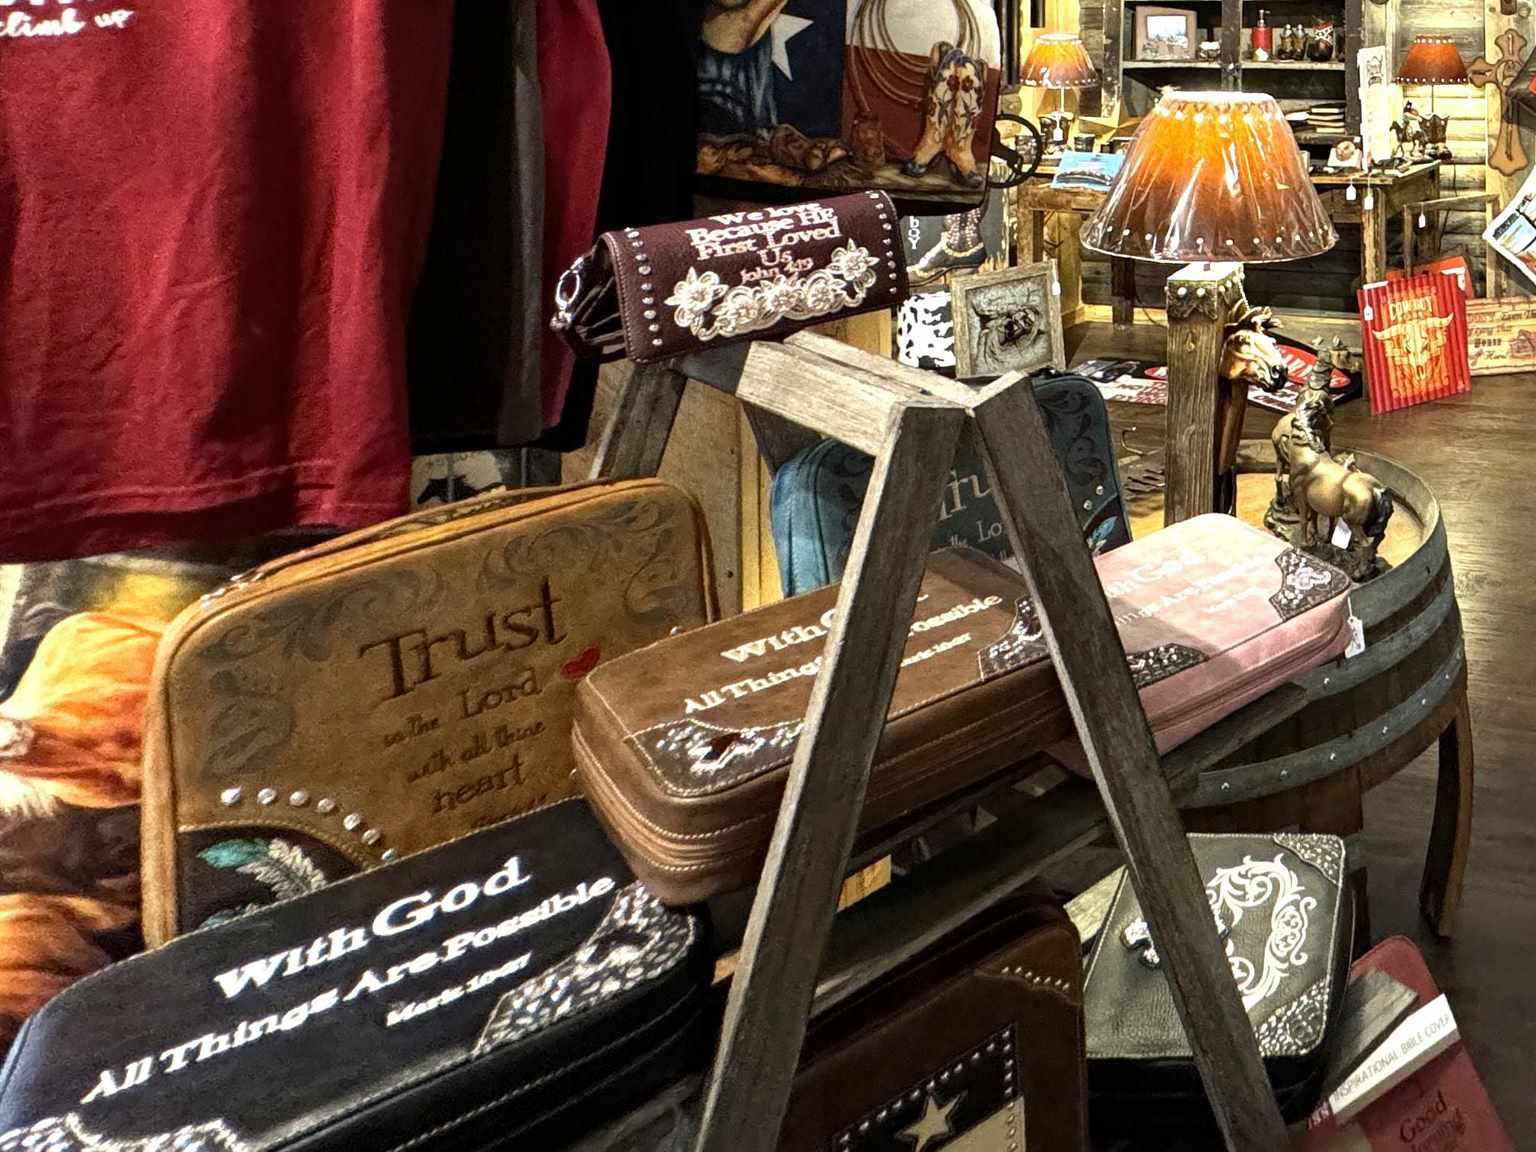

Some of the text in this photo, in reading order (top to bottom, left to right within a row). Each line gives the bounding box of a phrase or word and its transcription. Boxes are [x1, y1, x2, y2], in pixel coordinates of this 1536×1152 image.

[94, 9, 135, 28] up
[685, 218, 794, 245] Because
[708, 211, 764, 225] We
[765, 216, 842, 249] Loved
[740, 267, 780, 284] John
[757, 249, 792, 266] Us
[357, 575, 568, 705] Trust
[684, 691, 724, 714] All
[908, 595, 1003, 637] ossible
[457, 666, 544, 721] Lord
[459, 732, 493, 763] all
[431, 752, 527, 816] heart
[213, 856, 533, 1001] With God
[80, 875, 618, 1105] All Things Are Possible
[1333, 1049, 1400, 1103] INSPIRATIONAL
[1400, 1032, 1424, 1056] BIBLE
[1400, 1089, 1448, 1143] Good
